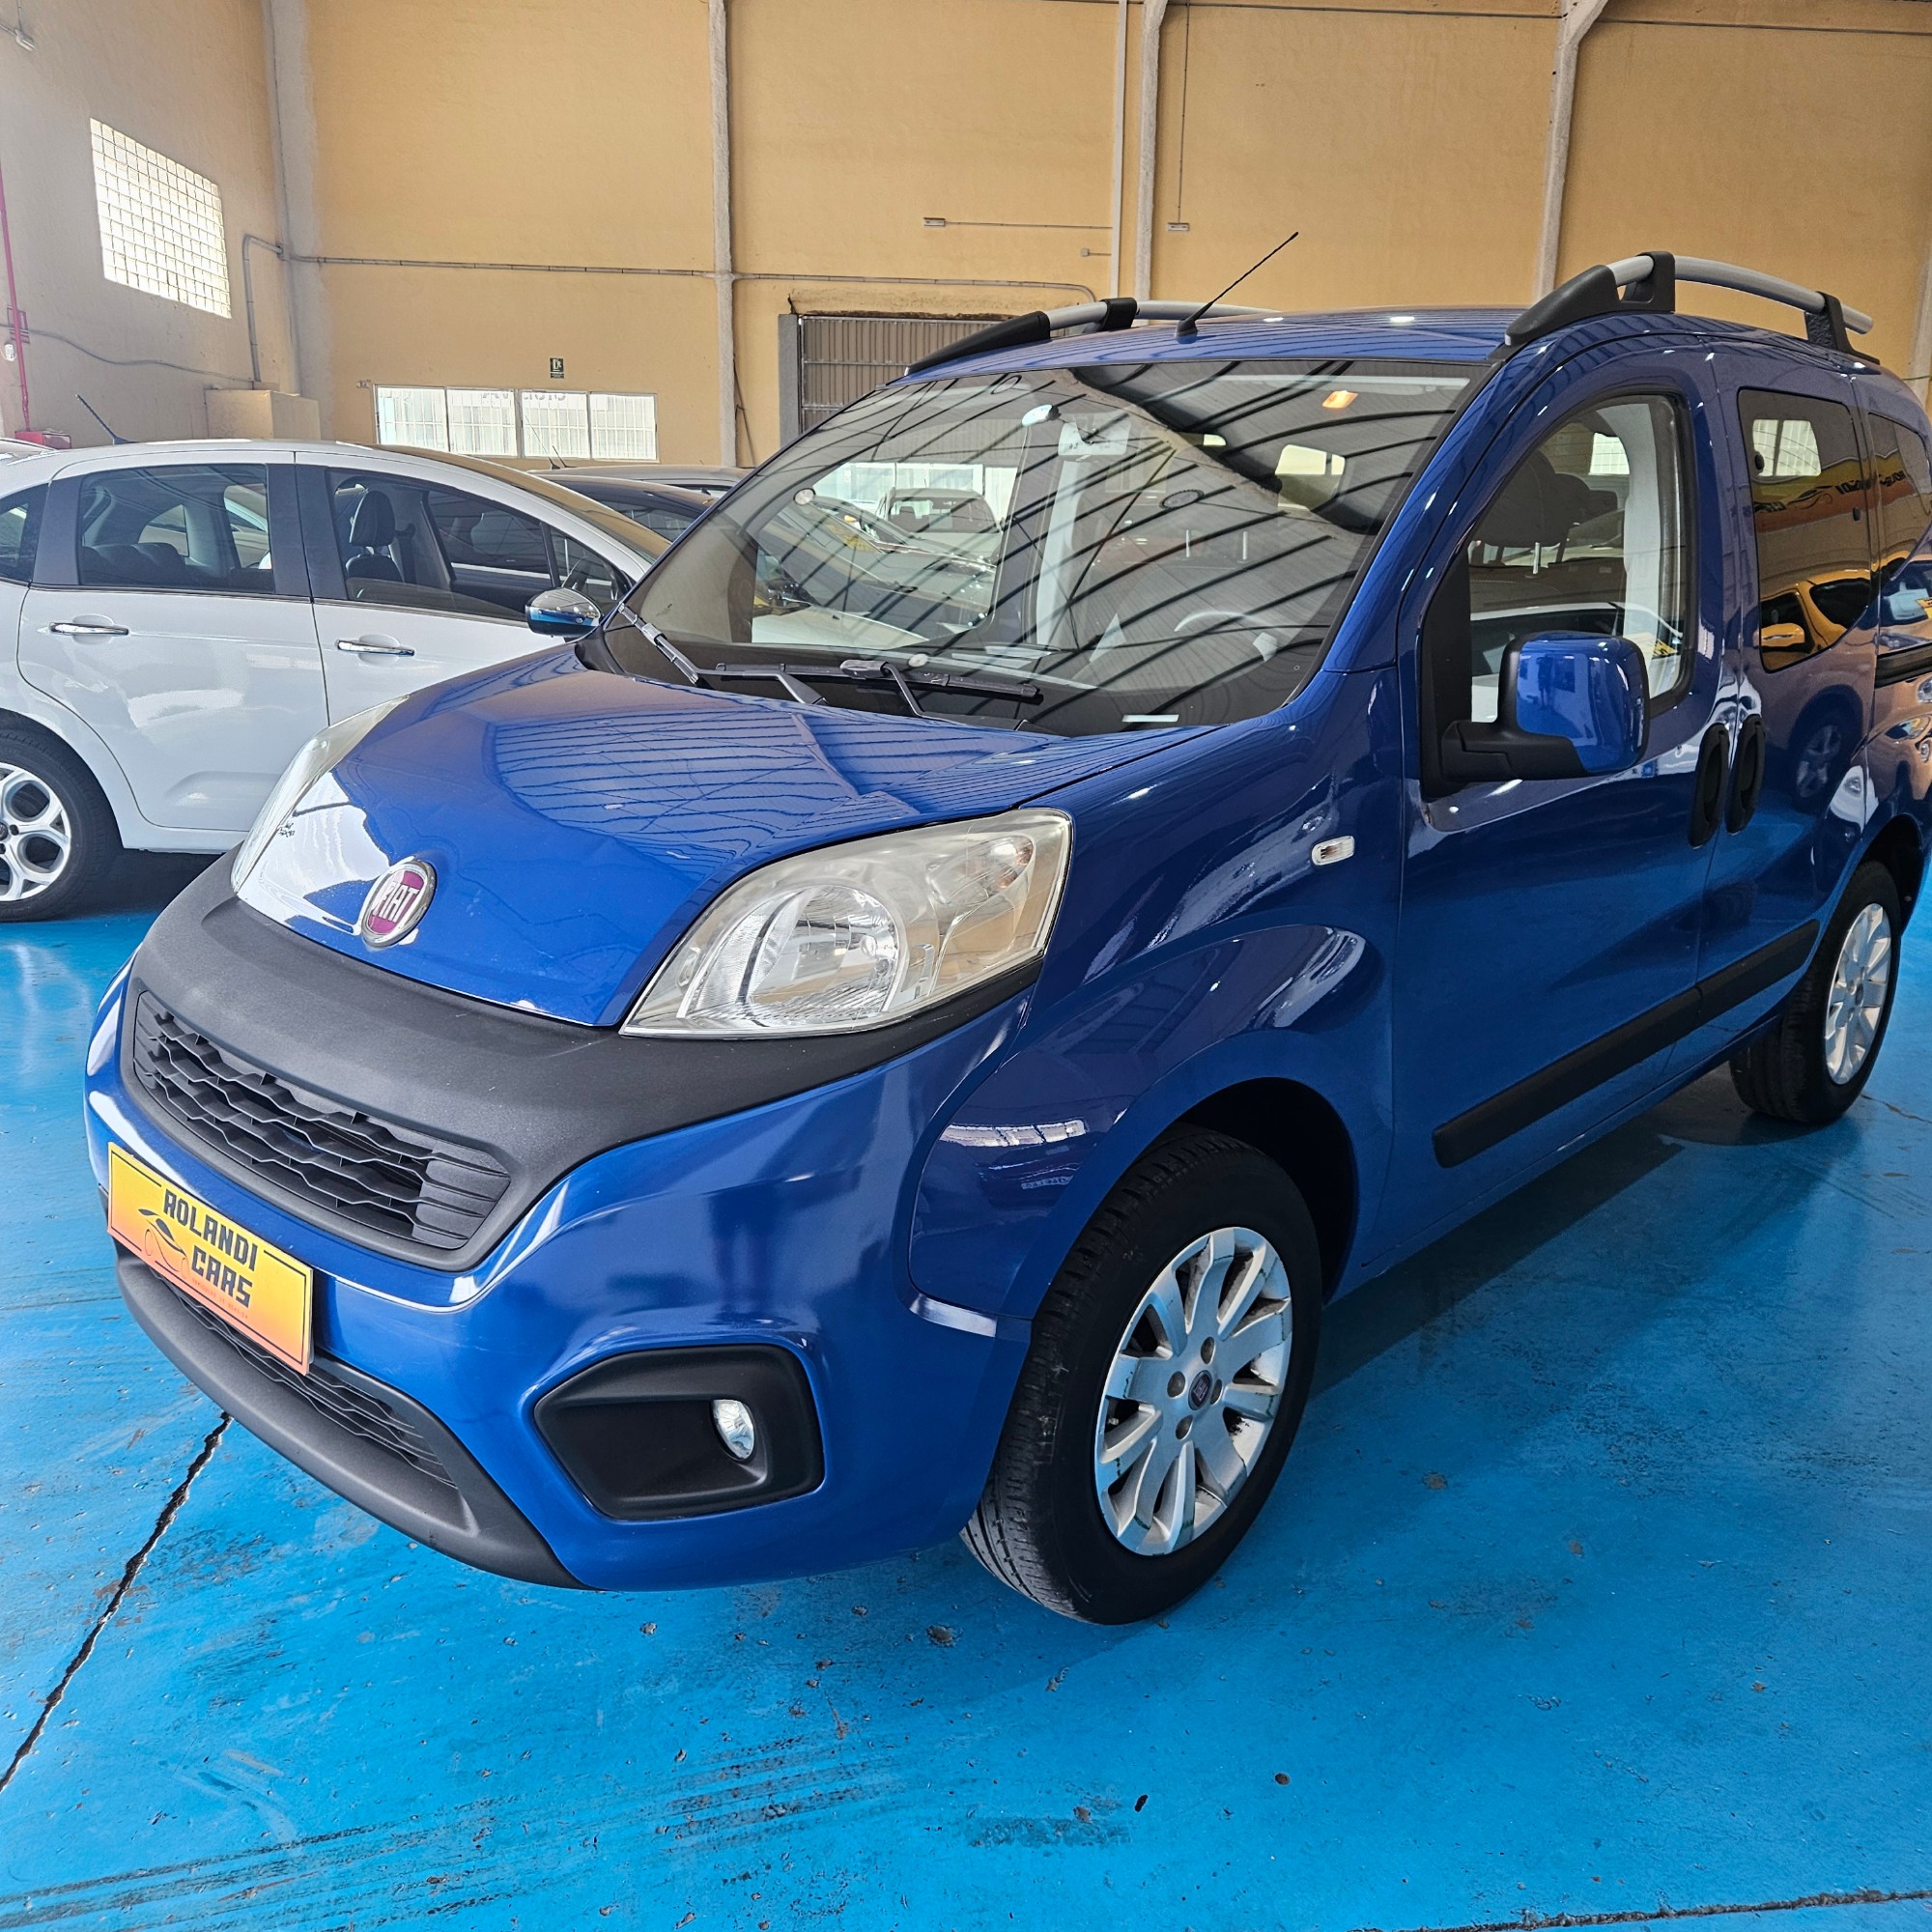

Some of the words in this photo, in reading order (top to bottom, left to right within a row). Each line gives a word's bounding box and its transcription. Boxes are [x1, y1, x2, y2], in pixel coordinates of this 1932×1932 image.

[371, 880, 420, 923] FIAT
[163, 1188, 258, 1271] ROLANDI
[191, 1245, 253, 1309] CARS
